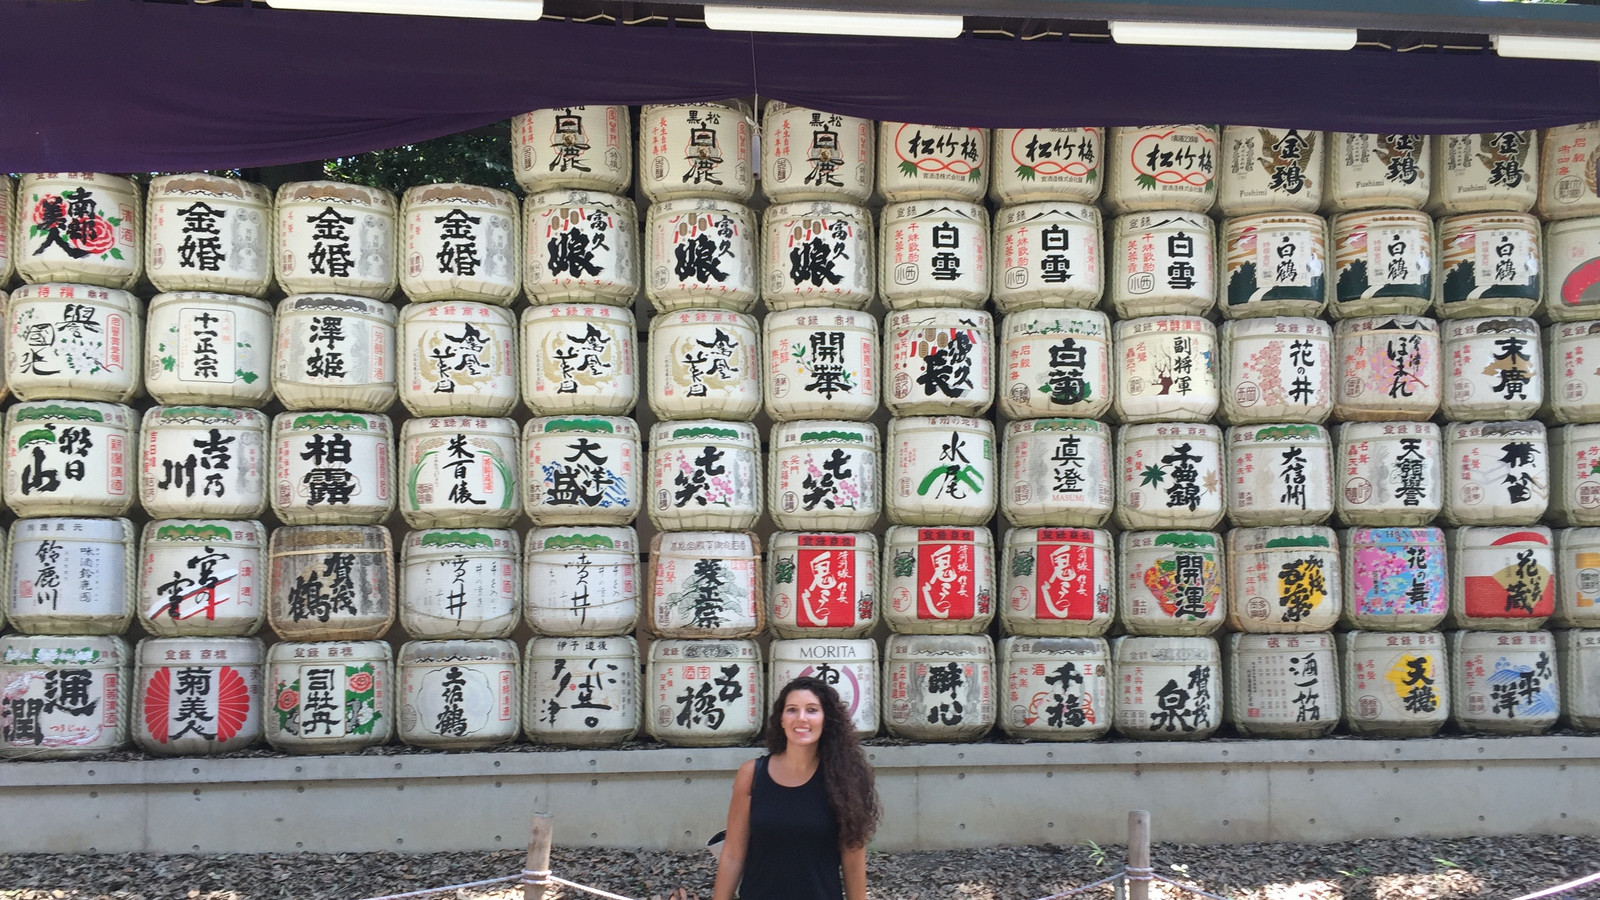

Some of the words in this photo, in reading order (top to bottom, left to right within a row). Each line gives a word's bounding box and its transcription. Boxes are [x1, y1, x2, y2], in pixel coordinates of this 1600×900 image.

[549, 108, 591, 172] 白鹿
[687, 110, 721, 125] 黒松
[810, 113, 843, 128] 黒松
[908, 130, 979, 162] 松竹梅
[1025, 134, 1095, 163] 松竹梅
[683, 121, 723, 185] 白鹿
[804, 125, 845, 187] 白鹿
[1146, 143, 1213, 173] 松竹梅
[67, 187, 97, 245] 南部
[1457, 185, 1487, 193] Fushimi
[32, 197, 86, 259] 美人
[177, 202, 227, 271] 金婚
[307, 207, 356, 277] 金婚
[435, 209, 482, 276] 金婚
[587, 209, 610, 251] 富久
[715, 215, 735, 258] 富久
[829, 220, 849, 260] 富久
[931, 221, 963, 281] 白雪
[1040, 224, 1074, 283] 白雪
[1276, 236, 1297, 282] 白鶴
[1388, 234, 1409, 280] 白鶴
[1496, 236, 1516, 281] 白鶴
[1168, 231, 1198, 290] 白雪
[194, 312, 219, 378] 十一正宗
[306, 317, 347, 378] 澤姫
[444, 323, 490, 375] 鳳凰
[567, 323, 611, 376] 鳳凰
[696, 328, 739, 379] 鳳凰
[805, 332, 852, 400] 開華
[1049, 338, 1087, 405] 白菊
[1289, 340, 1315, 406] 花の井
[1387, 337, 1413, 398] ほまれ
[1493, 337, 1531, 400] 末廣
[22, 447, 60, 495] 山
[158, 454, 197, 497] 川
[300, 433, 356, 505] 柏露
[443, 434, 487, 505] 米百俵
[674, 446, 725, 508] 七笑
[802, 448, 852, 511] 七笑
[935, 431, 971, 500] 水尾
[1162, 443, 1203, 512] 千曲錦
[1279, 446, 1307, 510] 大信州
[35, 540, 63, 610] 鈴鹿川
[157, 546, 229, 618] 宮の雪
[801, 552, 837, 626] 鬼ころし
[922, 545, 957, 618] 鬼ころし
[1041, 545, 1076, 618] 鬼ころし
[1174, 556, 1208, 619] 開運
[1405, 547, 1430, 607] 花の舞
[800, 645, 856, 658] MORITA
[169, 666, 218, 741] 菊美人
[302, 668, 341, 735] 司牡丹
[435, 667, 468, 736] 土佐鶴
[676, 664, 743, 731] 五橋
[1045, 662, 1086, 728] 千福
[1151, 679, 1194, 732] 泉
[1289, 652, 1320, 722] 酒一筋
[1490, 651, 1552, 718] 太平洋
